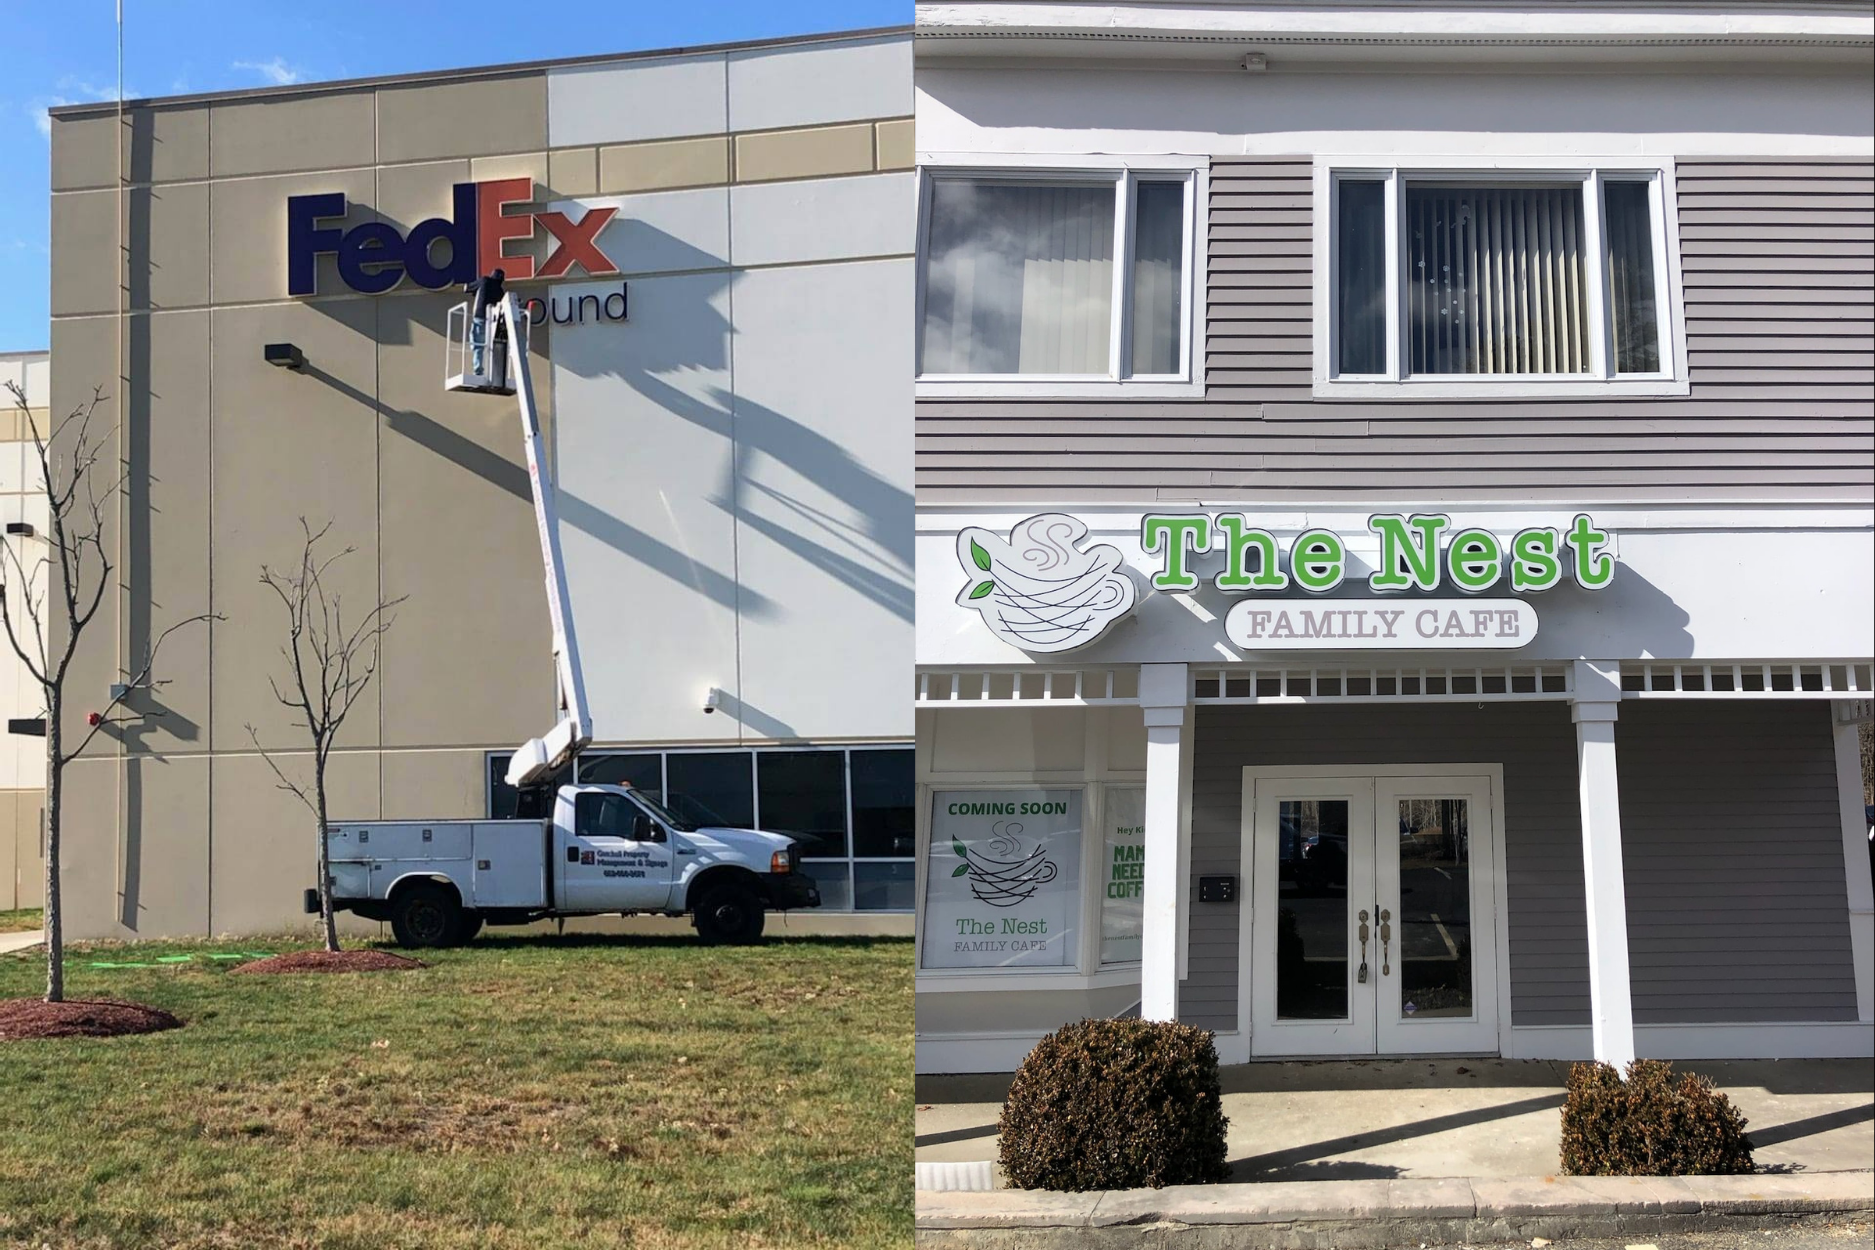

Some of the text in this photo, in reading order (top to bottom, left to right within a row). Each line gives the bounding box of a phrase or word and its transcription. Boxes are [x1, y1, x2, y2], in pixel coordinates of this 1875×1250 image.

[288, 177, 620, 296] FedEx
[518, 282, 628, 325] ound
[1143, 514, 1615, 592] The Nest
[1246, 609, 1520, 638] FAMILY CAFE
[948, 802, 1067, 815] COMING SOON
[1117, 825, 1145, 836] Hey Ki
[1114, 845, 1145, 862] MAM
[1112, 863, 1145, 880] NEED
[1107, 881, 1144, 898] COFF
[955, 918, 1048, 935] The Nest
[953, 940, 1047, 952] FAMILY CAFE
